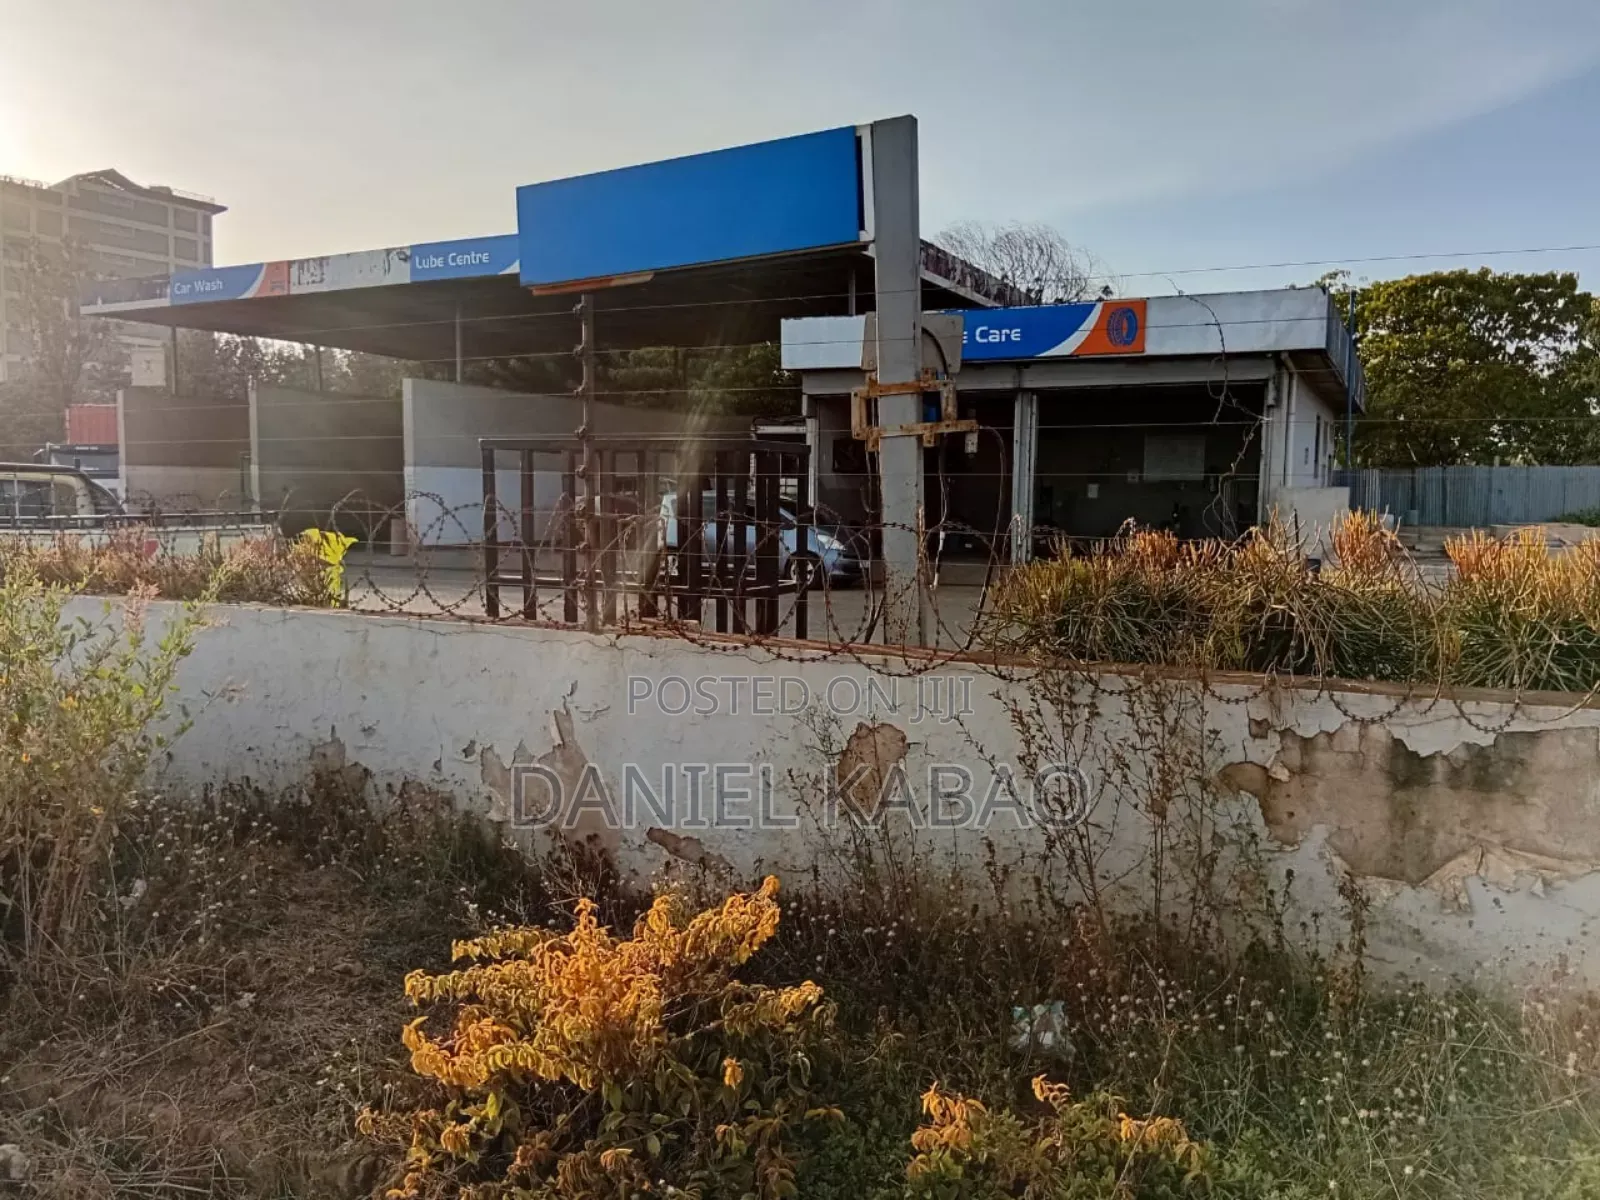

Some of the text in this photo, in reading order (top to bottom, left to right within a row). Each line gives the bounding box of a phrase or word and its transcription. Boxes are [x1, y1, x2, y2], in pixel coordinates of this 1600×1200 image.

[415, 251, 489, 269] Lube Centre
[174, 278, 223, 295] Car Wash
[975, 326, 1021, 343] Care
